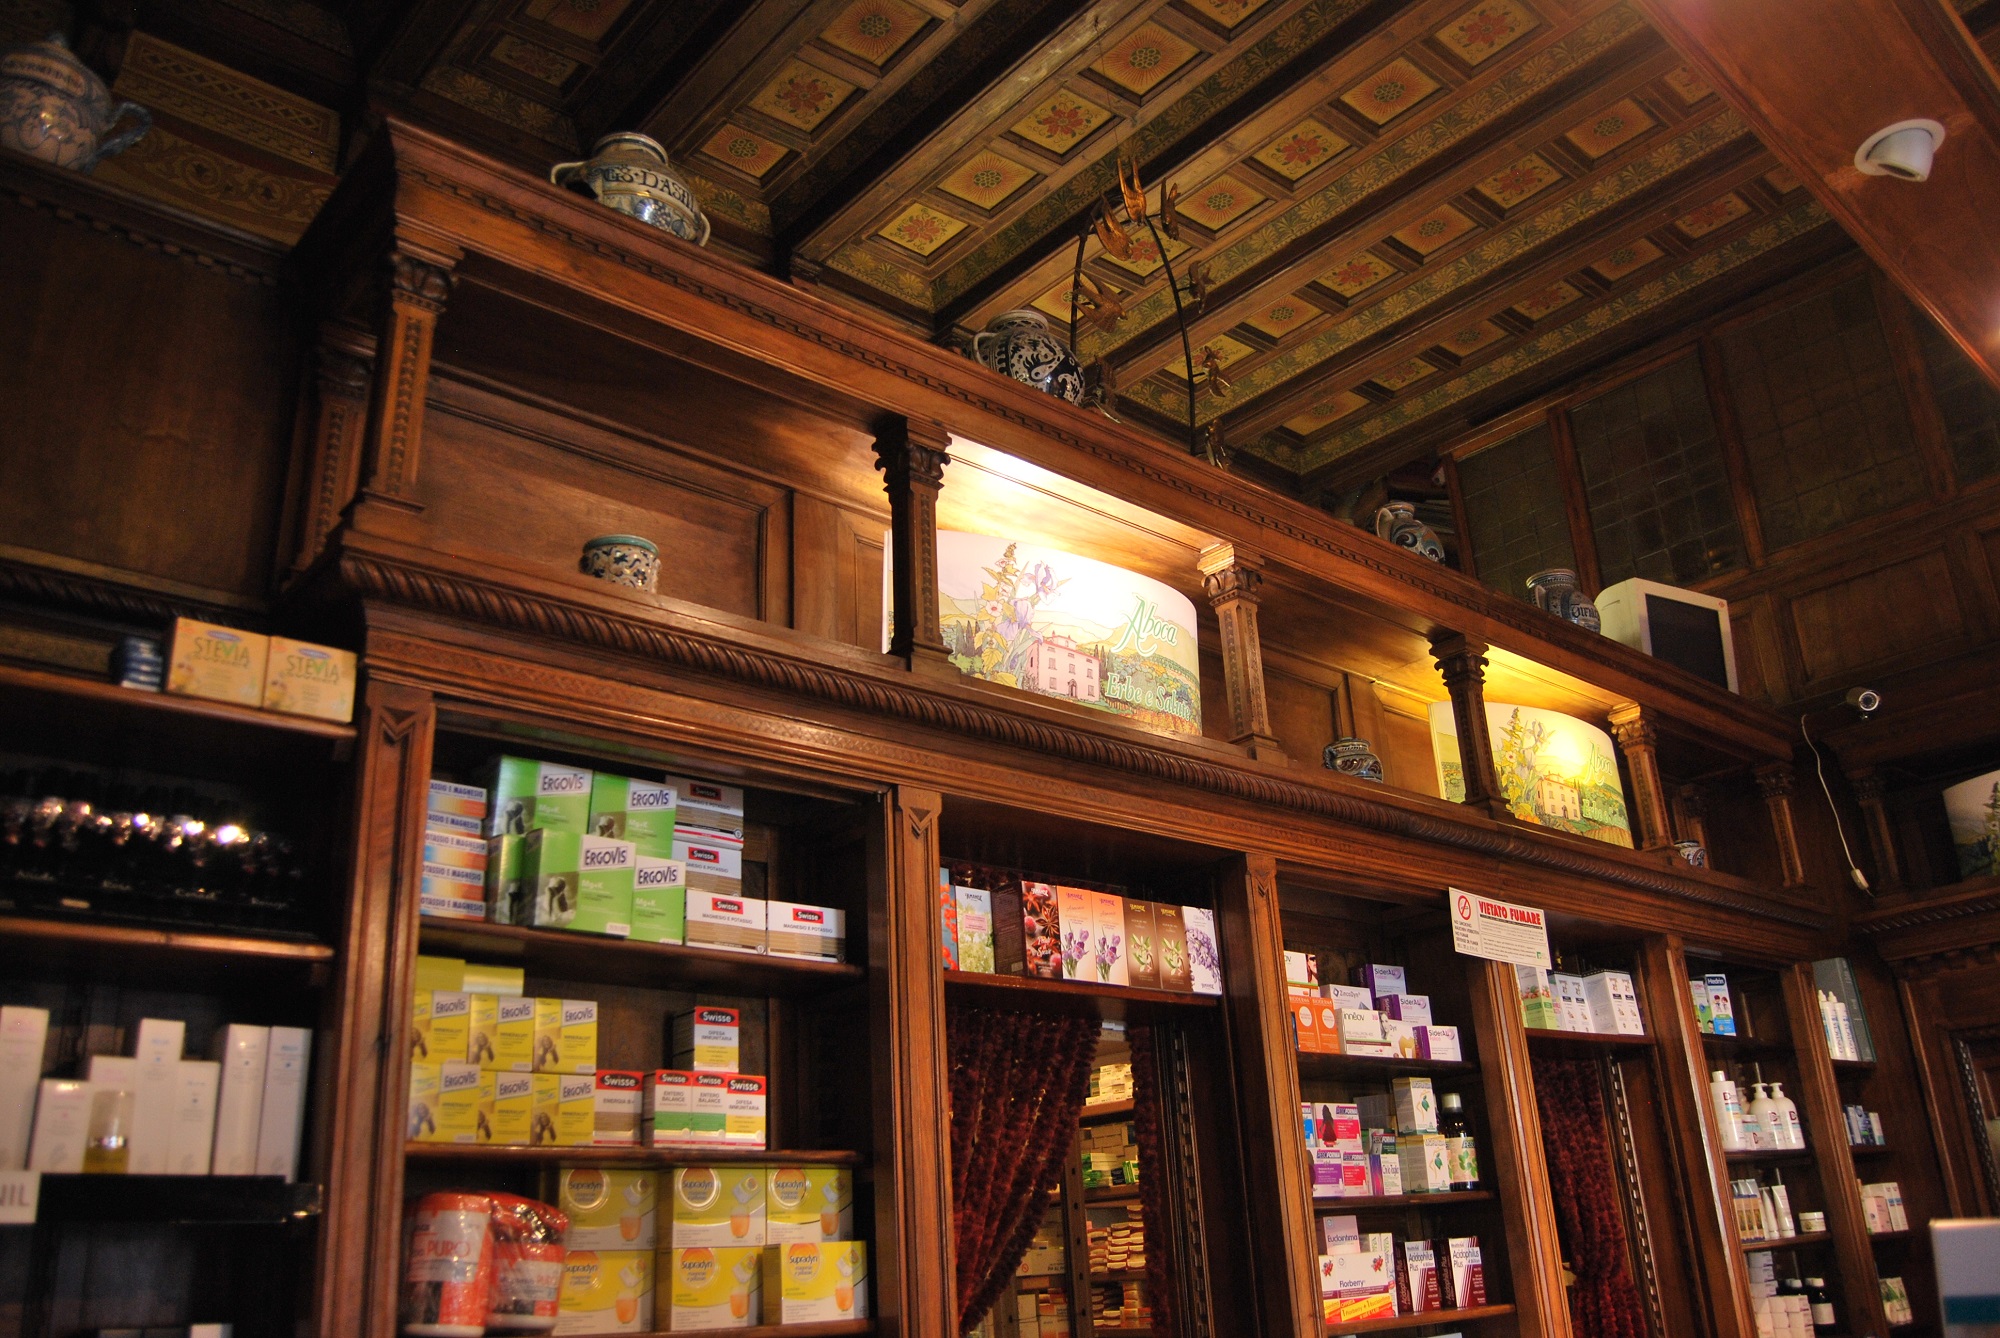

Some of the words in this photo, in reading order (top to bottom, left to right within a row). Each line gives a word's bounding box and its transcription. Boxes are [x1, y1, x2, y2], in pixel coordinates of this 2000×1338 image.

[1111, 595, 1179, 658] Aboca
[194, 636, 250, 664] STEVIA
[287, 654, 341, 682] STEVIA
[1105, 672, 1143, 704] Erbe
[1145, 691, 1154, 707] e
[1156, 690, 1193, 721] Salute
[542, 773, 584, 791] ERGOVIS
[453, 786, 484, 799] MAGNESIO
[631, 789, 669, 806] ERGOVIS
[694, 786, 717, 798] Swisse
[450, 818, 480, 830] MAGNESIO
[584, 847, 627, 866] ERGOVIS
[692, 850, 716, 861] Swisse
[451, 869, 482, 881] MAGNESIO
[637, 866, 678, 885] ERGOVIS
[452, 900, 484, 912] MAGNESIO
[716, 901, 739, 912] Swisse
[797, 911, 820, 922] Swisse
[1478, 900, 1508, 919] VIETATO
[1509, 907, 1542, 925] FUMARE
[702, 913, 727, 921] MAGNESIO
[731, 916, 753, 925] POTASSIO
[783, 923, 807, 931] MAGNESIO
[811, 926, 834, 934] POTASSIO
[1374, 968, 1396, 976] SiderAL
[1707, 977, 1725, 985] Hedrin
[436, 999, 466, 1014] ERGOVIS
[1400, 998, 1421, 1006] SiderAL
[501, 1004, 531, 1019] ERGOVIS
[564, 1007, 593, 1022] ERGOVIS
[702, 1010, 733, 1023] Swisse
[1428, 1029, 1450, 1037] SiderAL
[444, 1071, 476, 1088] ERGOVIS
[603, 1074, 636, 1088] Swisse
[661, 1073, 687, 1084] Swisse
[698, 1075, 723, 1085] Swisse
[499, 1079, 529, 1096] ERGOVIS
[562, 1083, 592, 1099] ERGOVIS
[729, 1079, 760, 1092] Swisse
[569, 1181, 603, 1191] Supradyn
[682, 1179, 714, 1190] Supradyn
[775, 1179, 804, 1190] Supradyn
[789, 1254, 818, 1264] Supradyn
[1408, 1251, 1434, 1264] Acidophilus
[1452, 1249, 1480, 1261] Acidophilus
[565, 1263, 599, 1274] Supradyn
[681, 1260, 713, 1270] Supradyn
[1409, 1263, 1419, 1272] Plus
[1453, 1260, 1464, 1268] Plus
[1339, 1279, 1364, 1289] Florberry
